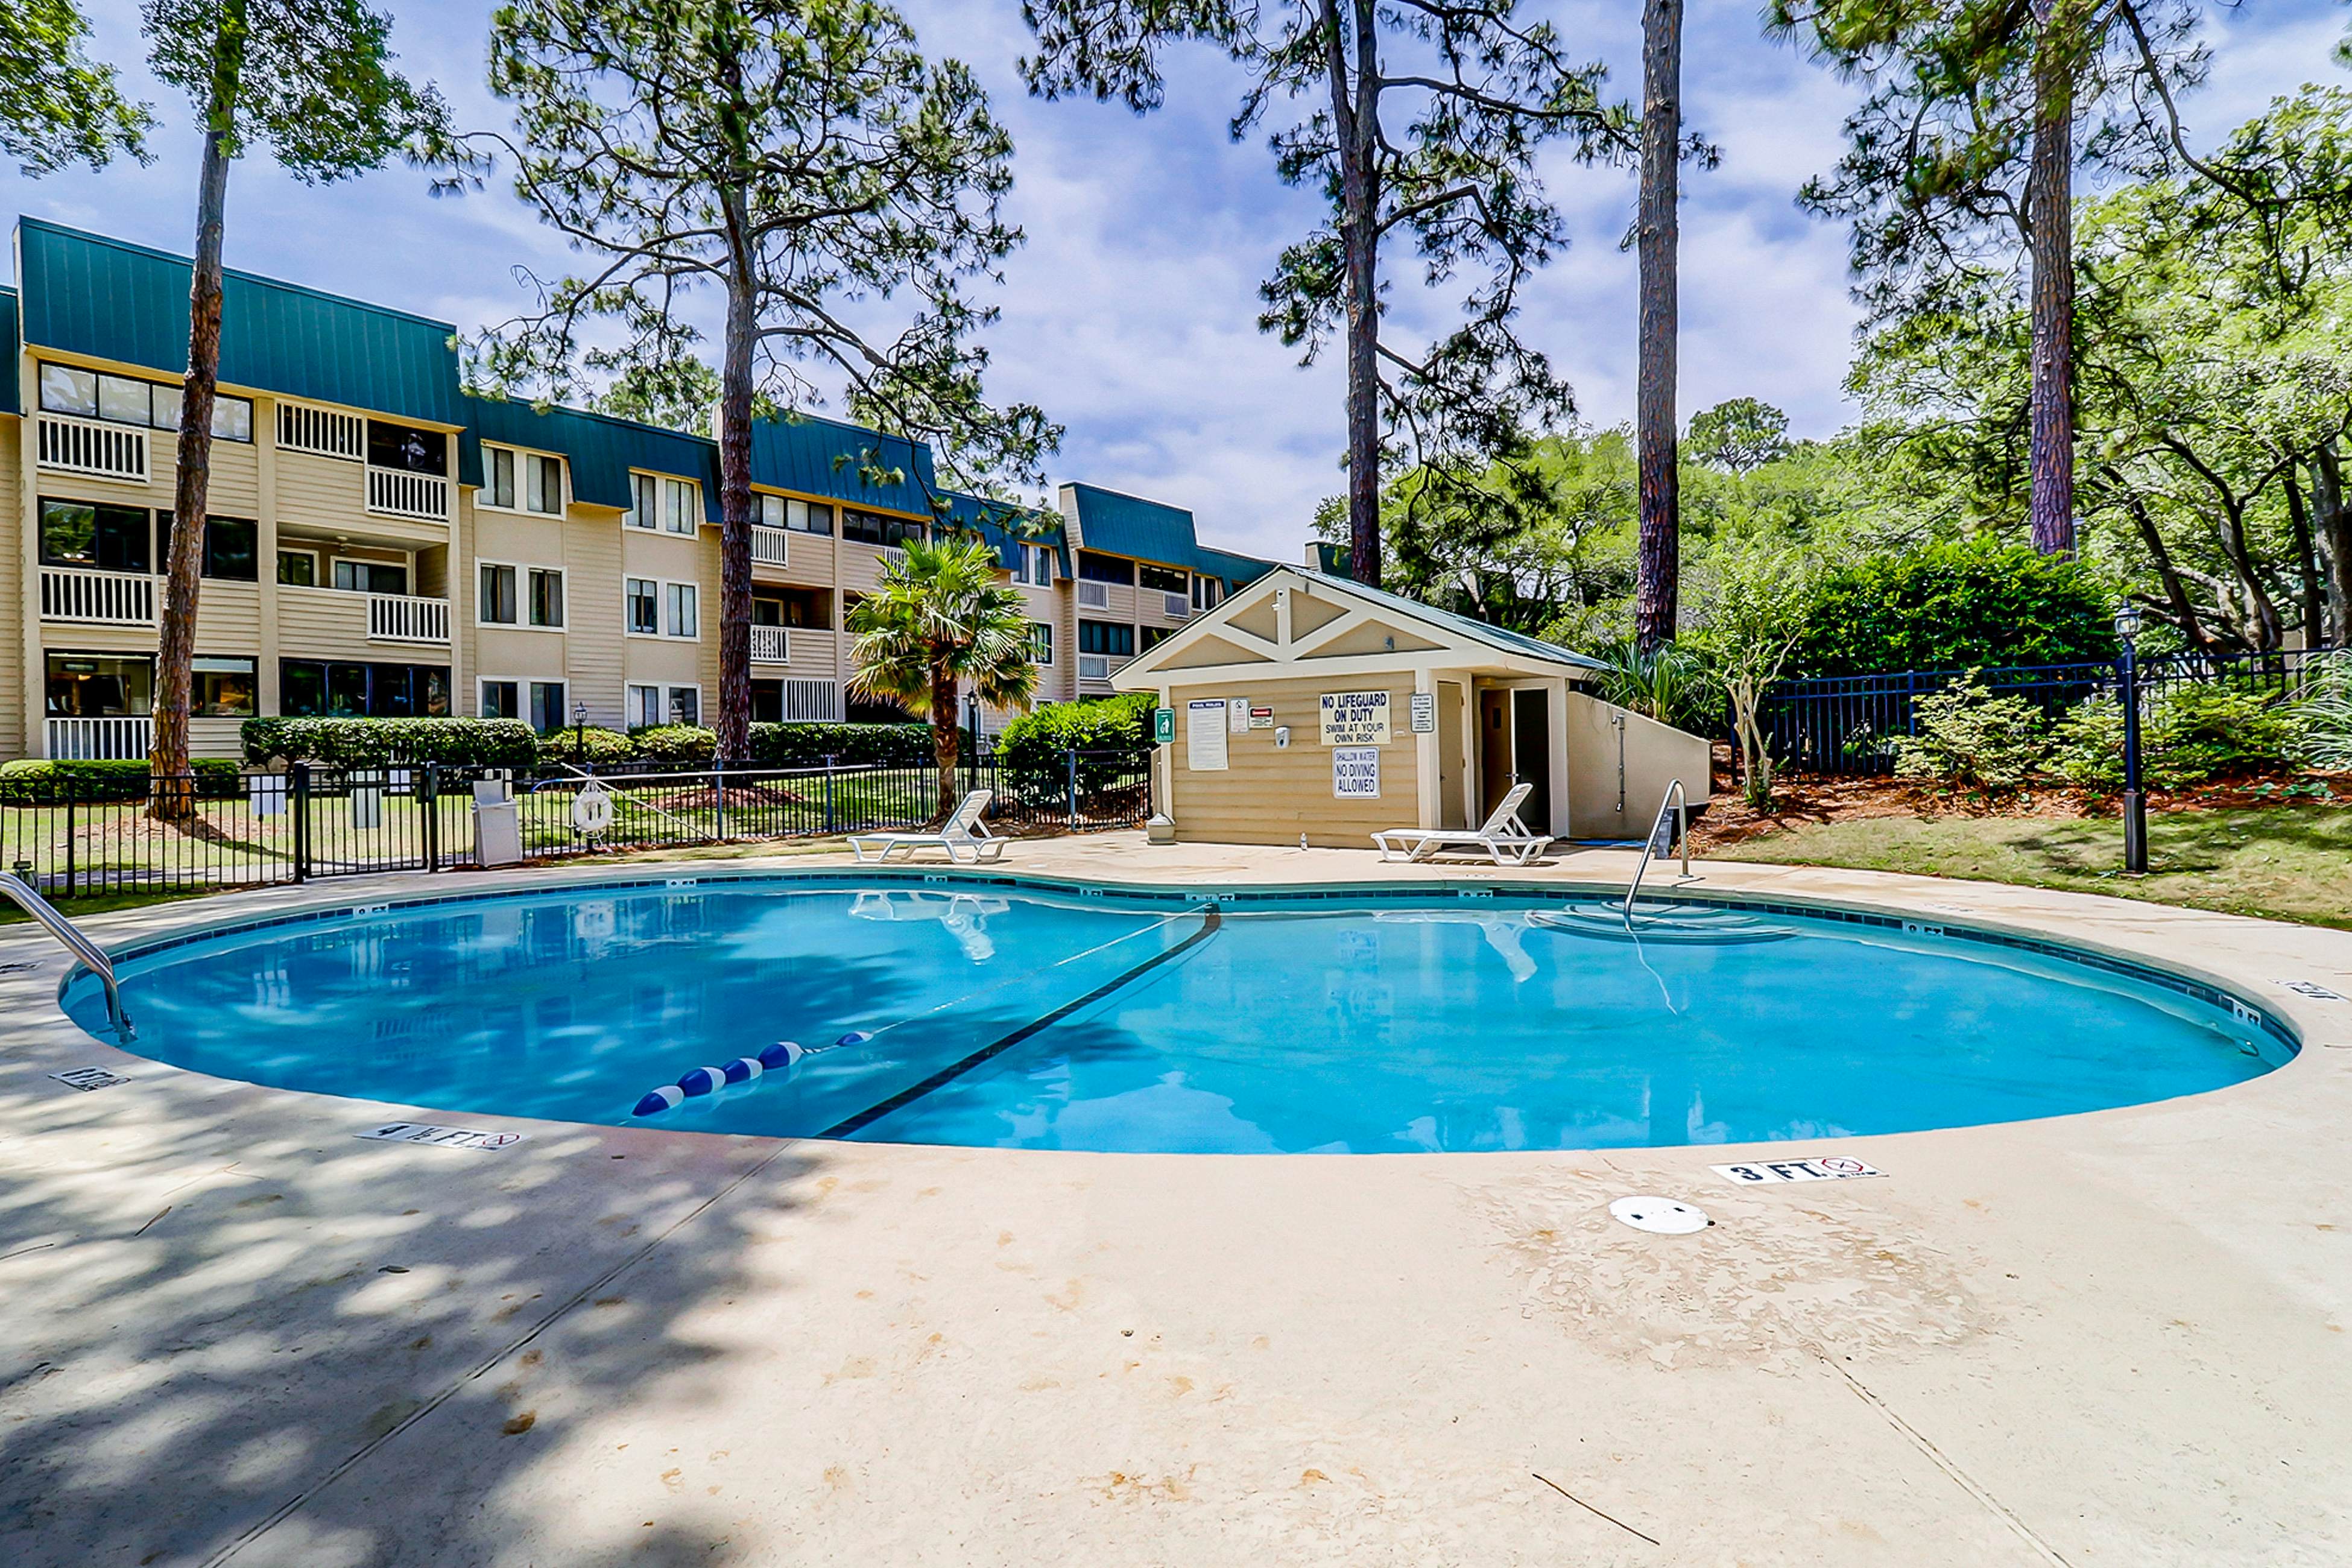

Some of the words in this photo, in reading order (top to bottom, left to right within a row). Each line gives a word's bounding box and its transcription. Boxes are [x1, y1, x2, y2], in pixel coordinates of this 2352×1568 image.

[1322, 696, 1334, 709] NO
[1338, 693, 1386, 708] LIFEGUARD
[1335, 709, 1347, 722] ON
[1350, 708, 1374, 722] DUTY
[1326, 724, 1345, 733] SWIM
[1348, 723, 1358, 732] AT
[1362, 722, 1384, 732] YOUR
[1335, 733, 1353, 743] OWN
[1356, 733, 1375, 742] RISK
[1336, 763, 1347, 777] NO
[1349, 763, 1376, 777] DIVING
[1338, 779, 1374, 792] ALLOWED
[1730, 1166, 1764, 1181] 3
